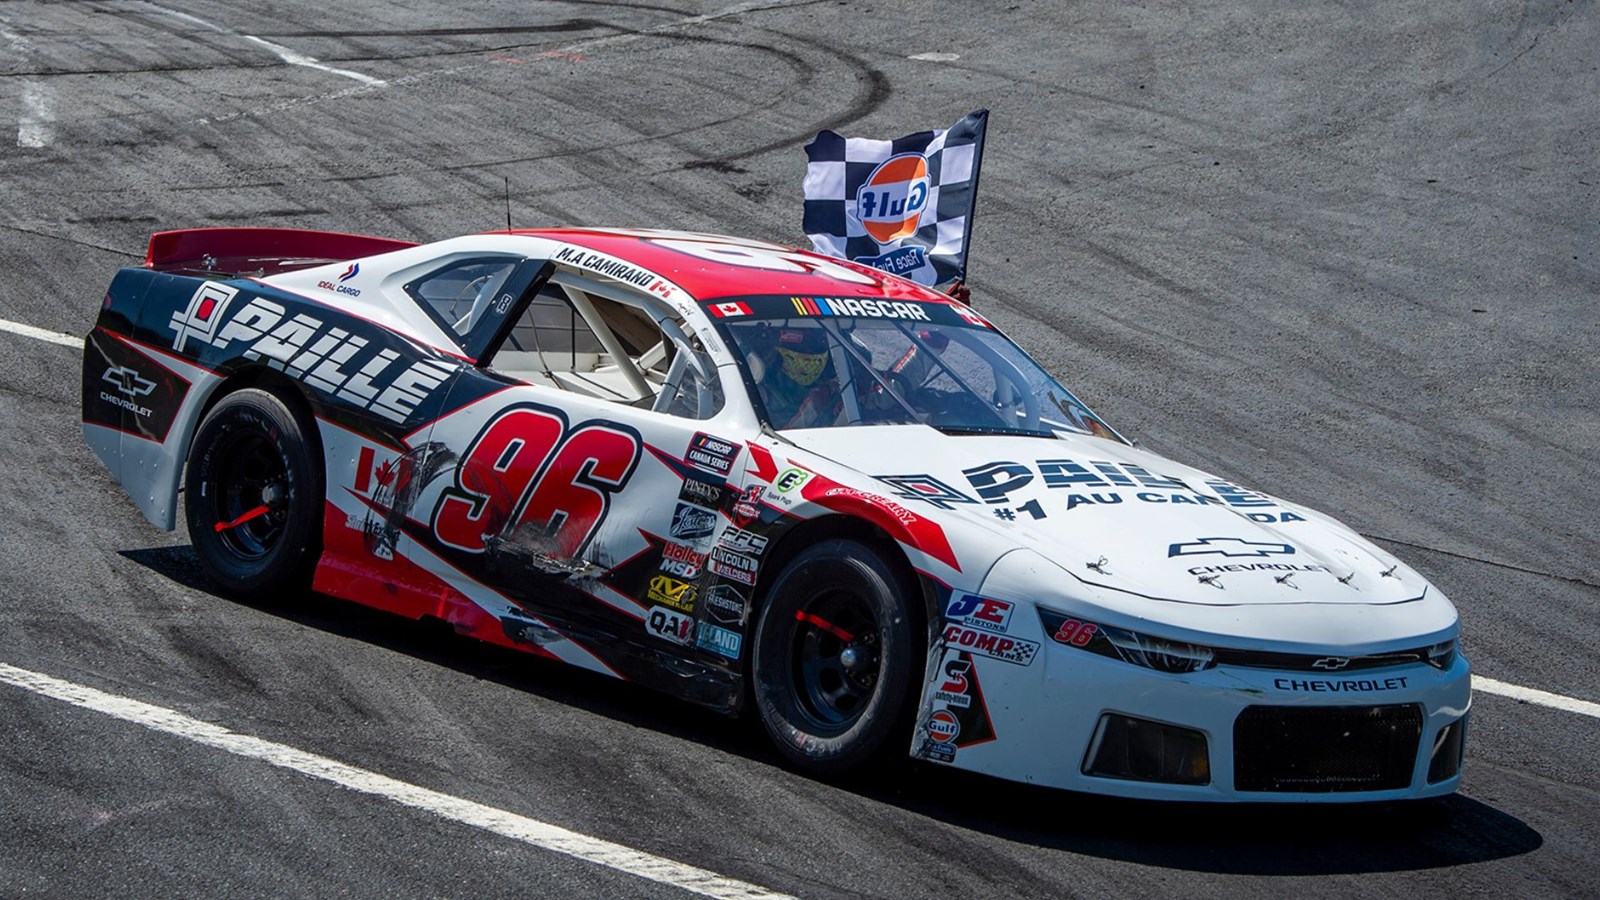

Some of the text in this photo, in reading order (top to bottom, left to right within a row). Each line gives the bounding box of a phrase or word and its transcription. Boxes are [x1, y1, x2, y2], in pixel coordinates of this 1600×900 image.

[582, 254, 655, 287] CAMIRAND
[336, 285, 361, 297] CARGO
[826, 298, 931, 321] NASCAR
[100, 391, 152, 418] CHEVROLET
[705, 440, 732, 455] NASCAR
[689, 450, 730, 471] CANADA SERIES
[429, 401, 643, 560] 96
[993, 492, 1307, 523] #1 AU CANDA
[721, 526, 767, 550] PFC
[662, 541, 708, 569] Holley
[712, 548, 750, 570] LINCOLN
[659, 559, 697, 577] MSD
[717, 564, 752, 582] WELDERS
[947, 594, 1011, 624] JE
[650, 611, 689, 639] QA1
[964, 616, 1006, 632] PISTONS
[1054, 618, 1098, 647] 96
[945, 626, 1015, 653] COMP
[988, 649, 1025, 662] CAMS
[1274, 677, 1408, 692] CHEVROLET
[928, 720, 956, 735] Gulf
